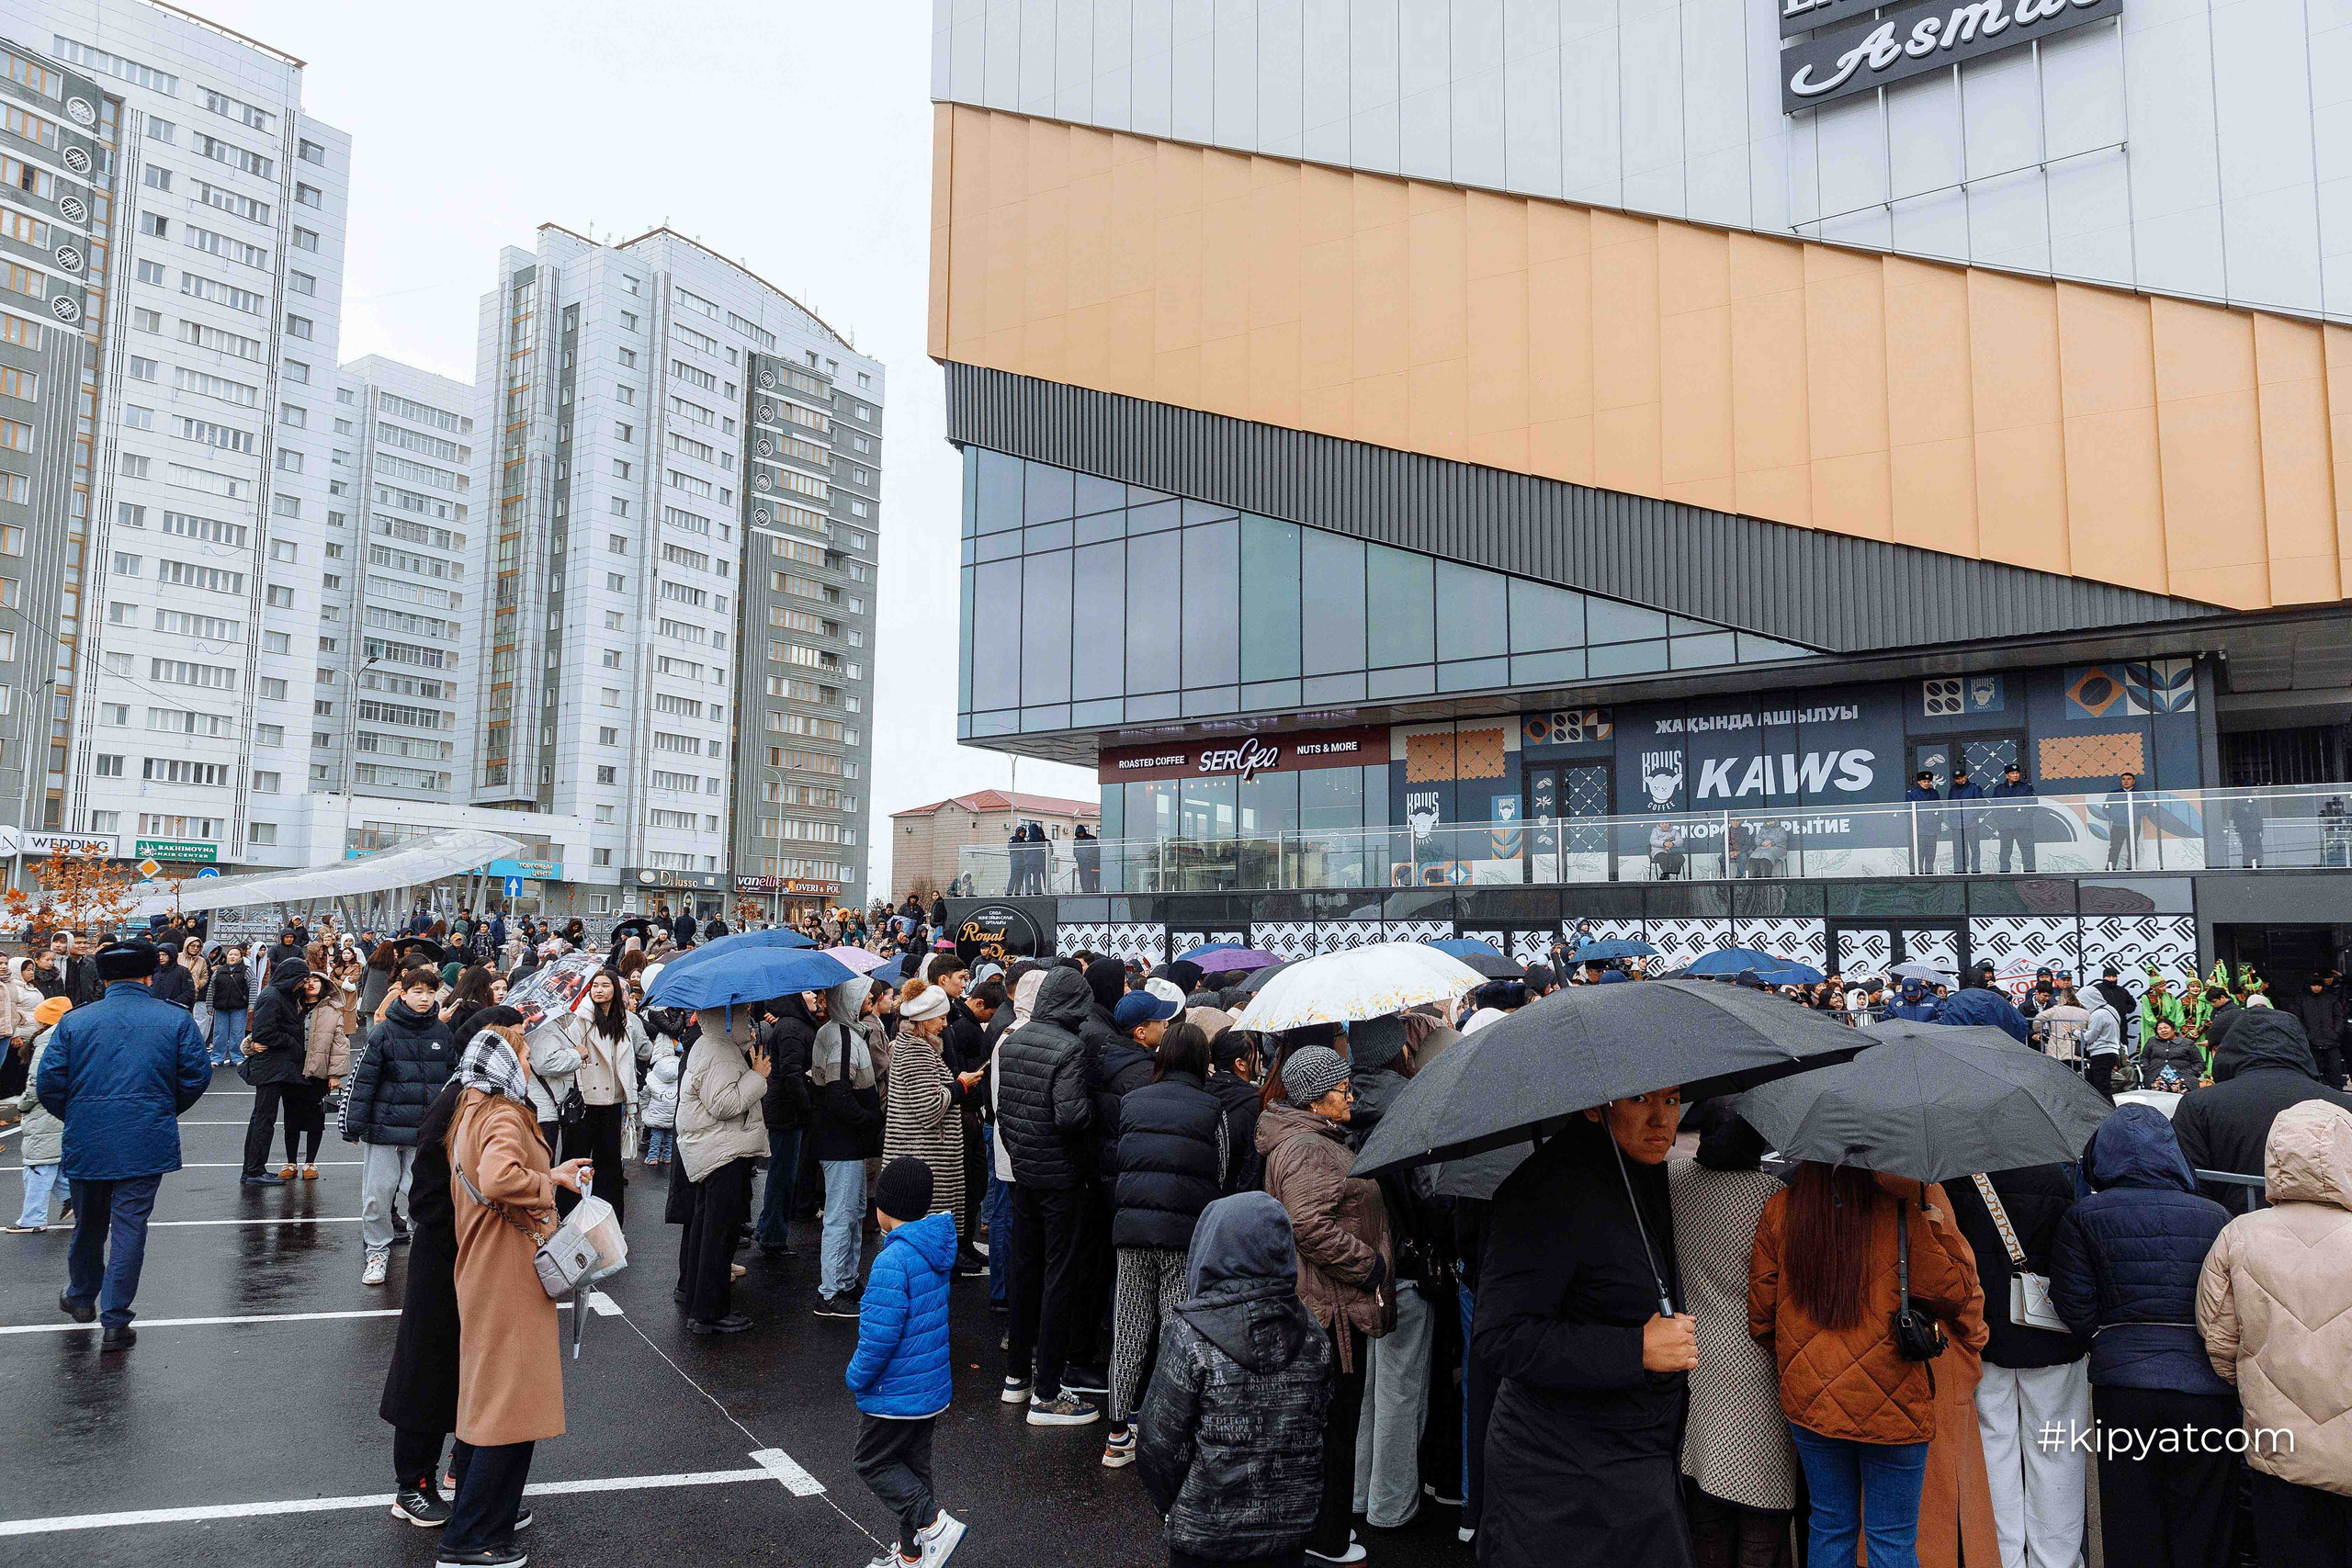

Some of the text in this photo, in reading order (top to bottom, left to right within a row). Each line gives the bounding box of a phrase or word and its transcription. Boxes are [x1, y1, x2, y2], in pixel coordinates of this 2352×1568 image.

[1655, 705, 1859, 734] ЖАҚЫНДА АШЫЛУЫ
[1297, 741, 1358, 755] NUTS & MORE
[1119, 755, 1185, 769] ROASTED COFFEE
[1697, 749, 1875, 798] KAWS
[1647, 800, 1676, 811] COFFEE
[1741, 818, 1850, 837] ОТРЫТИЕ
[158, 845, 214, 853] RAKHIMOVNA
[518, 862, 553, 870] ТОРГОВЫЙ
[796, 883, 819, 892] DVERI
[826, 885, 840, 894] POL
[960, 921, 1006, 942] Royal
